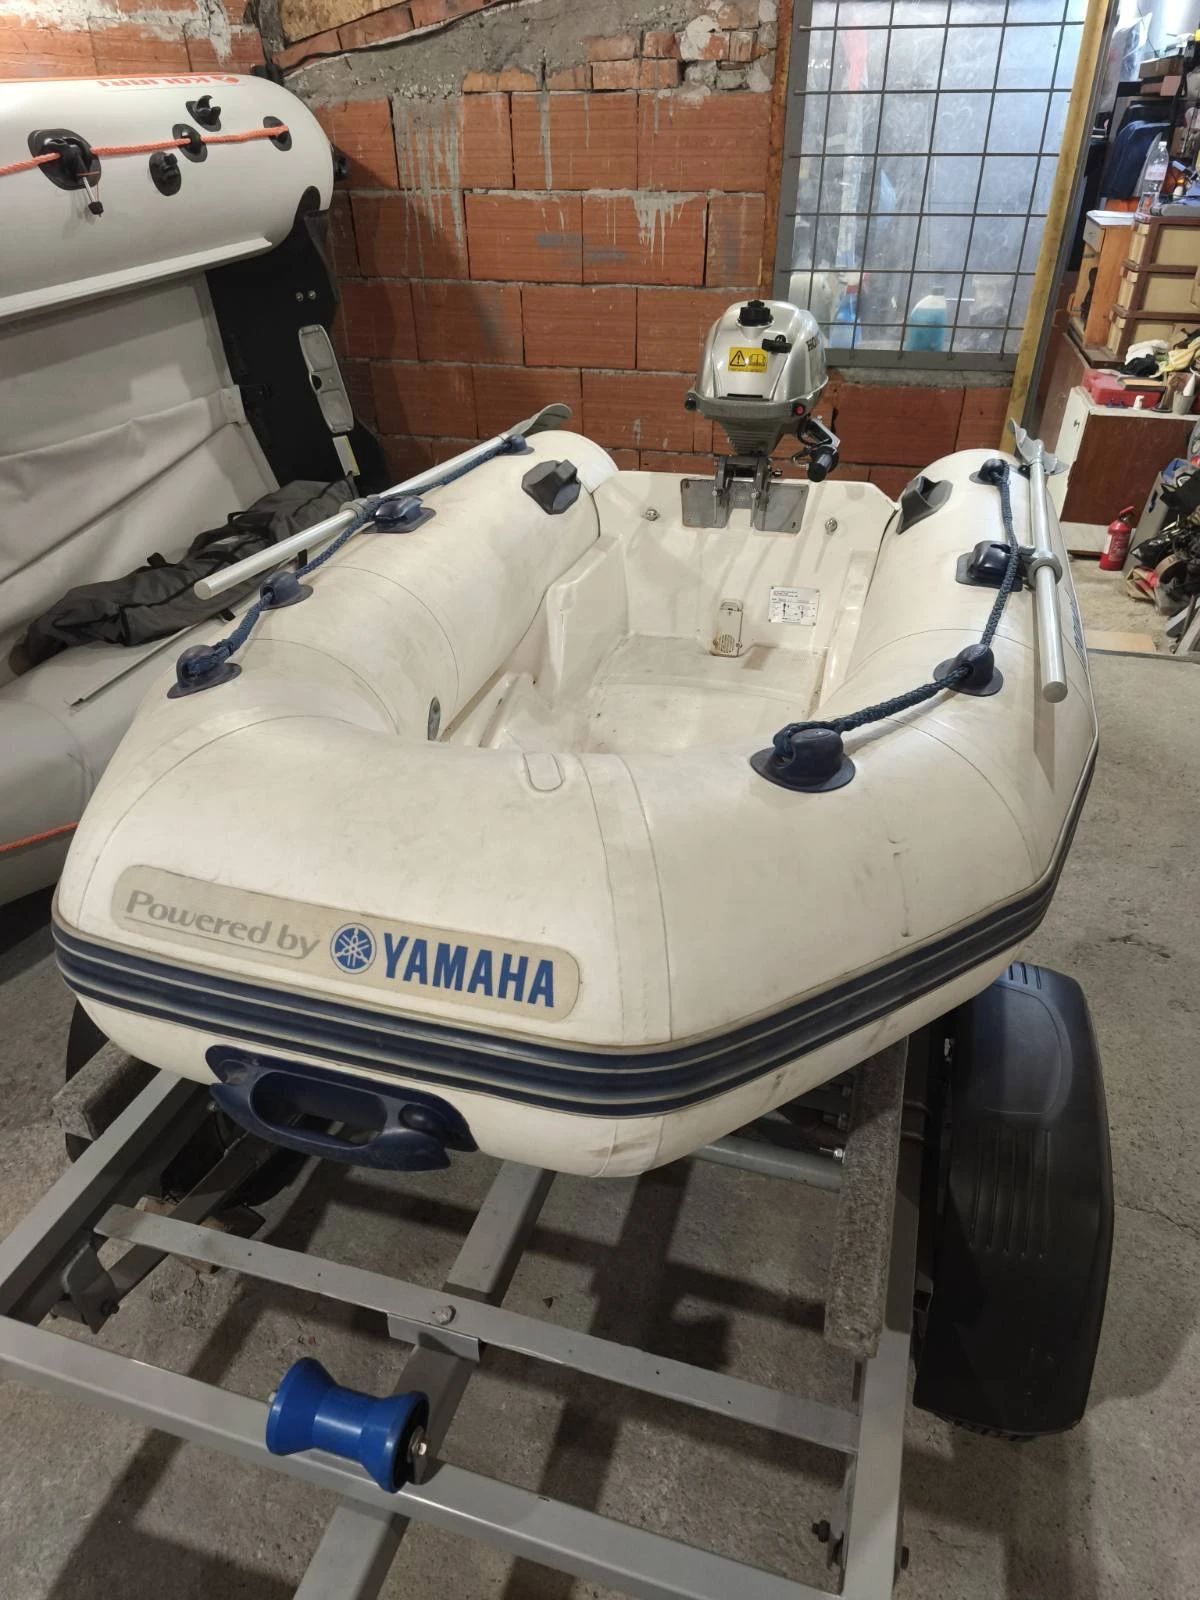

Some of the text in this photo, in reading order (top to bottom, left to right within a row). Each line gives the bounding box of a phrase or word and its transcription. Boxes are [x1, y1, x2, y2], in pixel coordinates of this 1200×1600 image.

[126, 890, 555, 1008] Powered by YAMAHA
